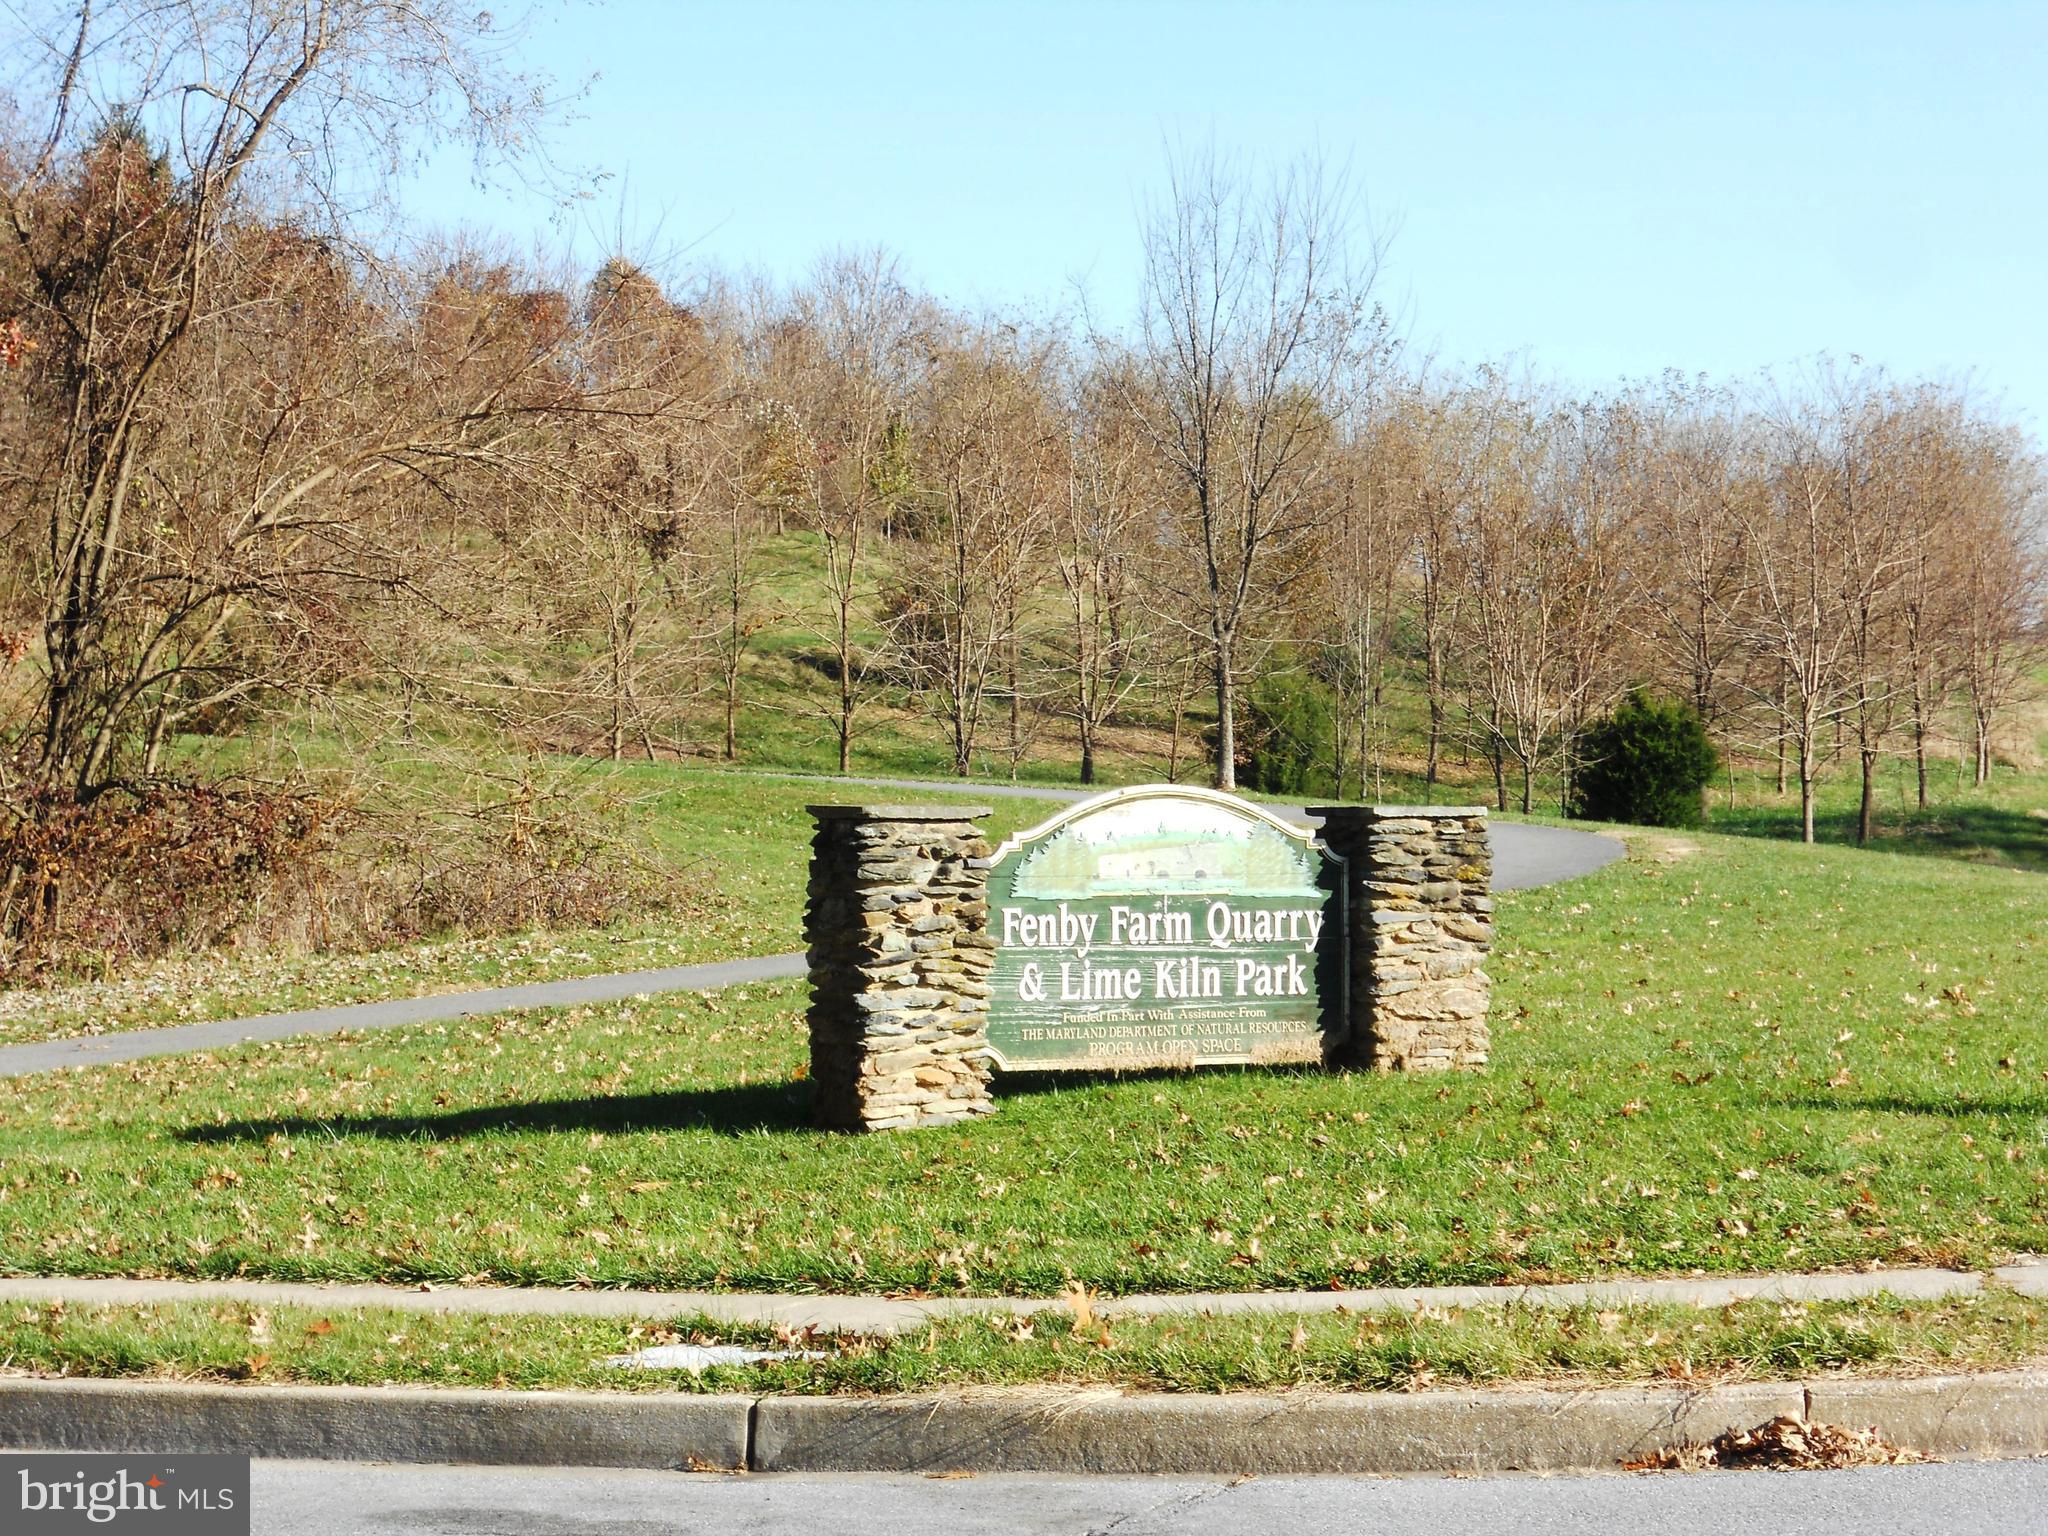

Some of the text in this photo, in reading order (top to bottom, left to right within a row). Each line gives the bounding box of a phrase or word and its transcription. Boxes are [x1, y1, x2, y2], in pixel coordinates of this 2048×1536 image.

[1001, 902, 1325, 958] Fenby Farm Quarry
[1018, 954, 1309, 1001] & Lime Kiln Park
[1063, 1007, 1267, 1024] Funded In Part With Assistance From
[1021, 1021, 1307, 1041] THE MARYLAND DEPARTMENT OF NATURAL RESOURCES
[1089, 1038, 1242, 1056] PROGRAM OPEN SPACE
